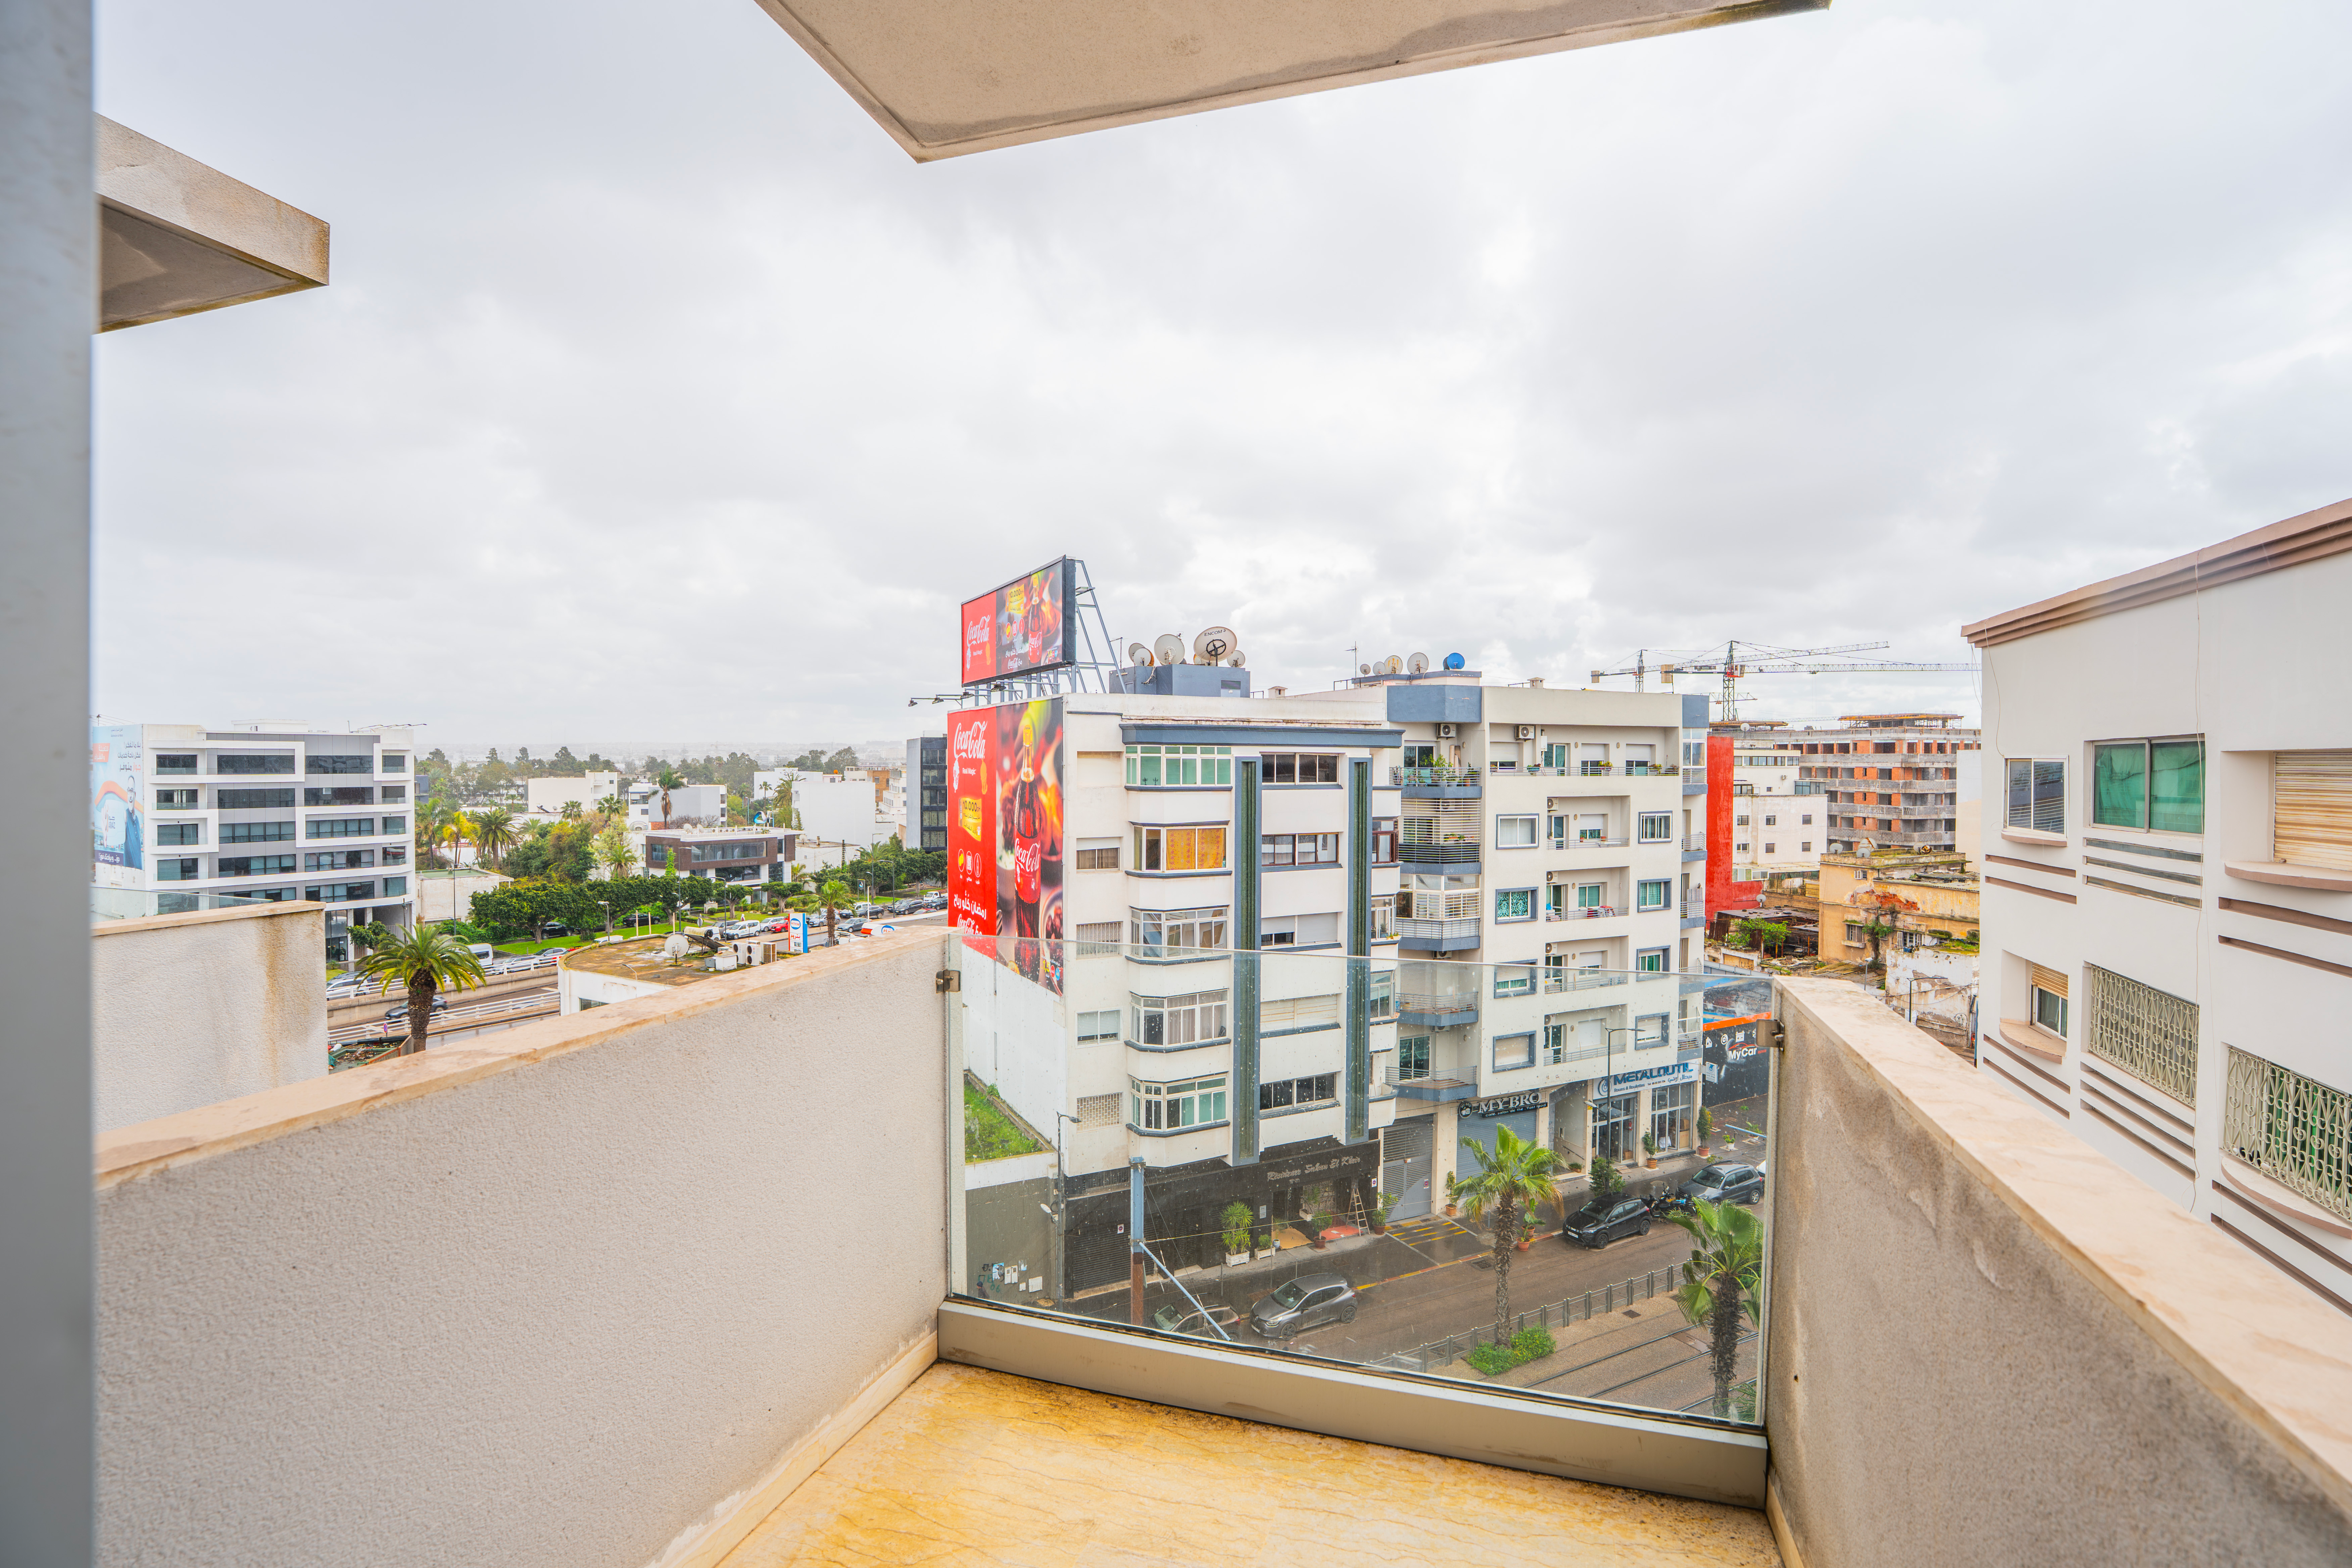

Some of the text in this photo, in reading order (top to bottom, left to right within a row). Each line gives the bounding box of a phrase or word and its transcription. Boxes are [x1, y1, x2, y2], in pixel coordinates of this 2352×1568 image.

[967, 614, 991, 647] Coca-Cola
[954, 720, 988, 759] Coca-Cola
[1015, 838, 1040, 872] Coca-Cola
[971, 900, 986, 920] رمضان
[1729, 1047, 1757, 1060] MyCar
[1614, 1062, 1693, 1085] METALOUTIL
[1478, 1092, 1542, 1114] MY BRO
[1304, 1162, 1328, 1174] Sakan
[1329, 1158, 1340, 1169] El
